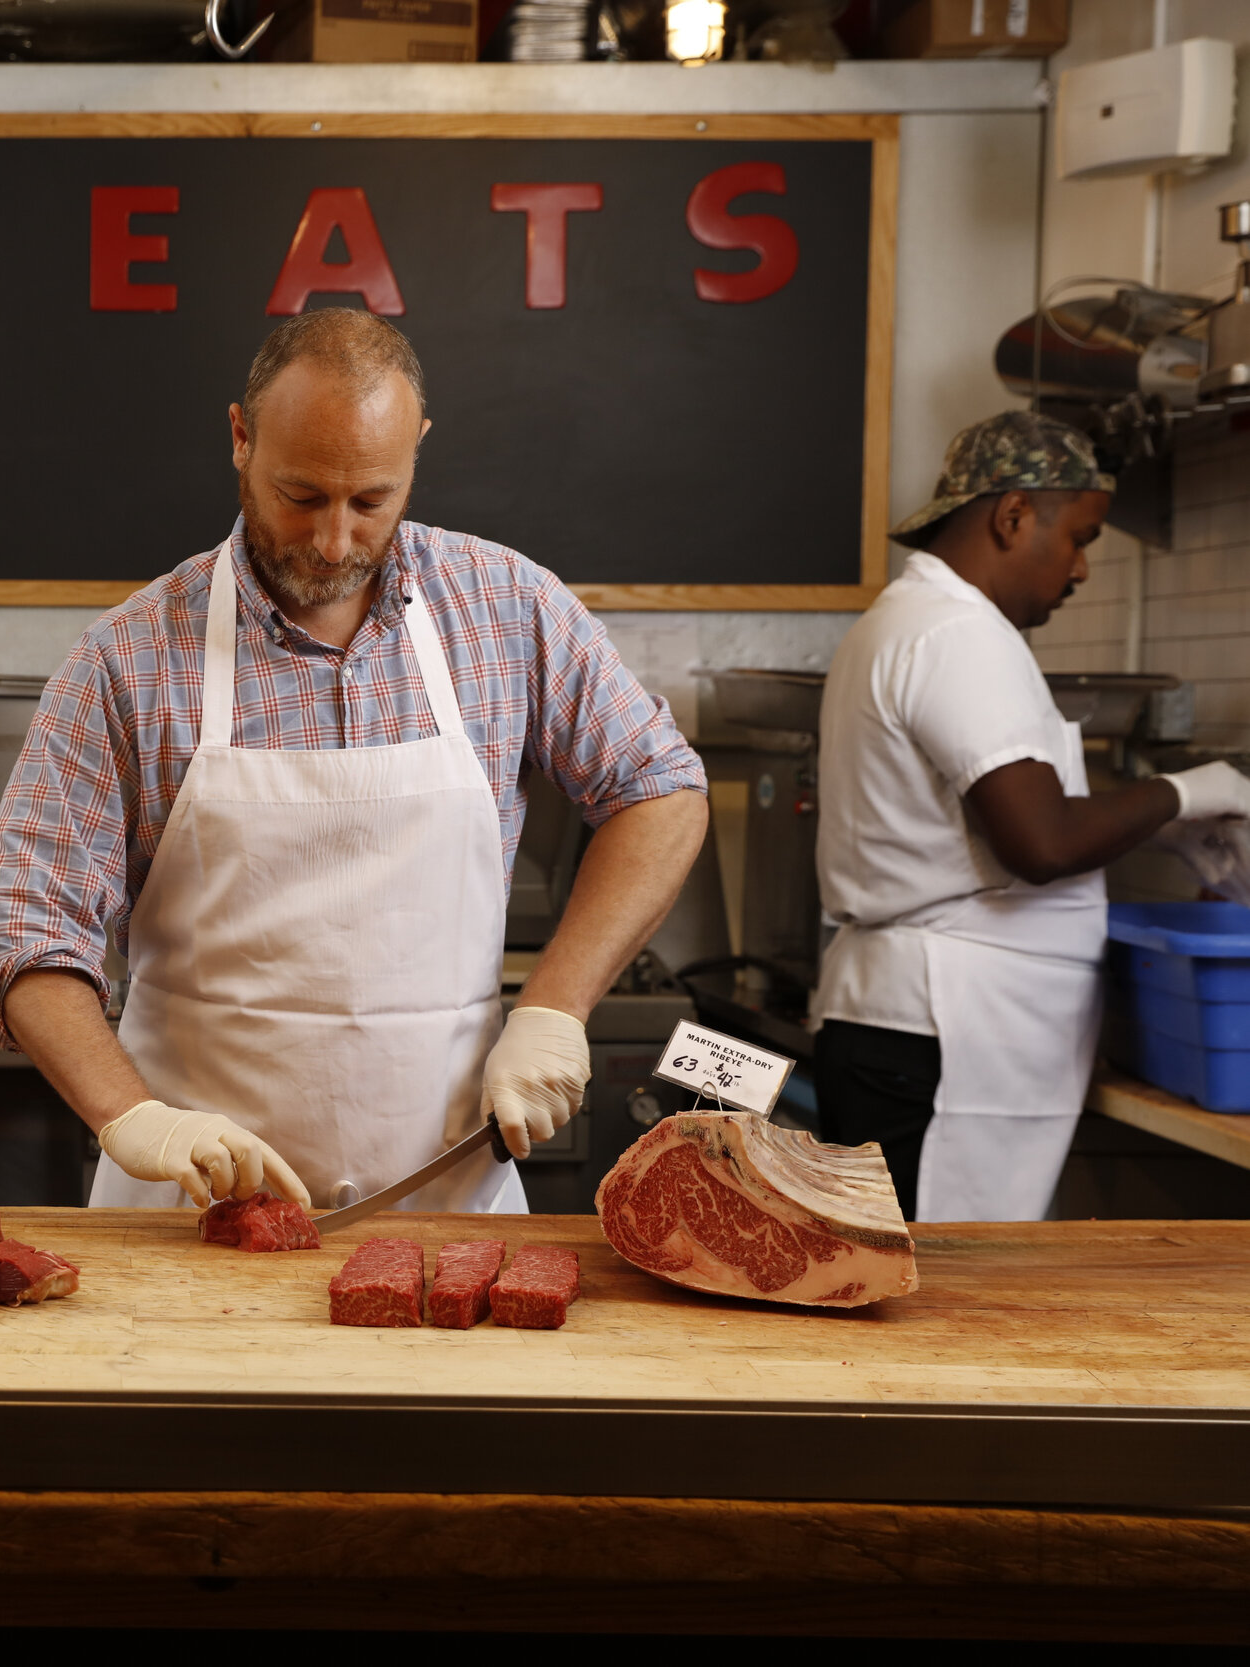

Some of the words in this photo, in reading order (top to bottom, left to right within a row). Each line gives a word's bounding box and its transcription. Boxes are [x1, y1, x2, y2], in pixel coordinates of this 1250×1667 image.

[686, 1033, 721, 1050] MARTIN
[723, 1047, 774, 1071] EXTRA-DRY
[710, 1050, 743, 1067] RIBEYE
[672, 1055, 699, 1072] 63
